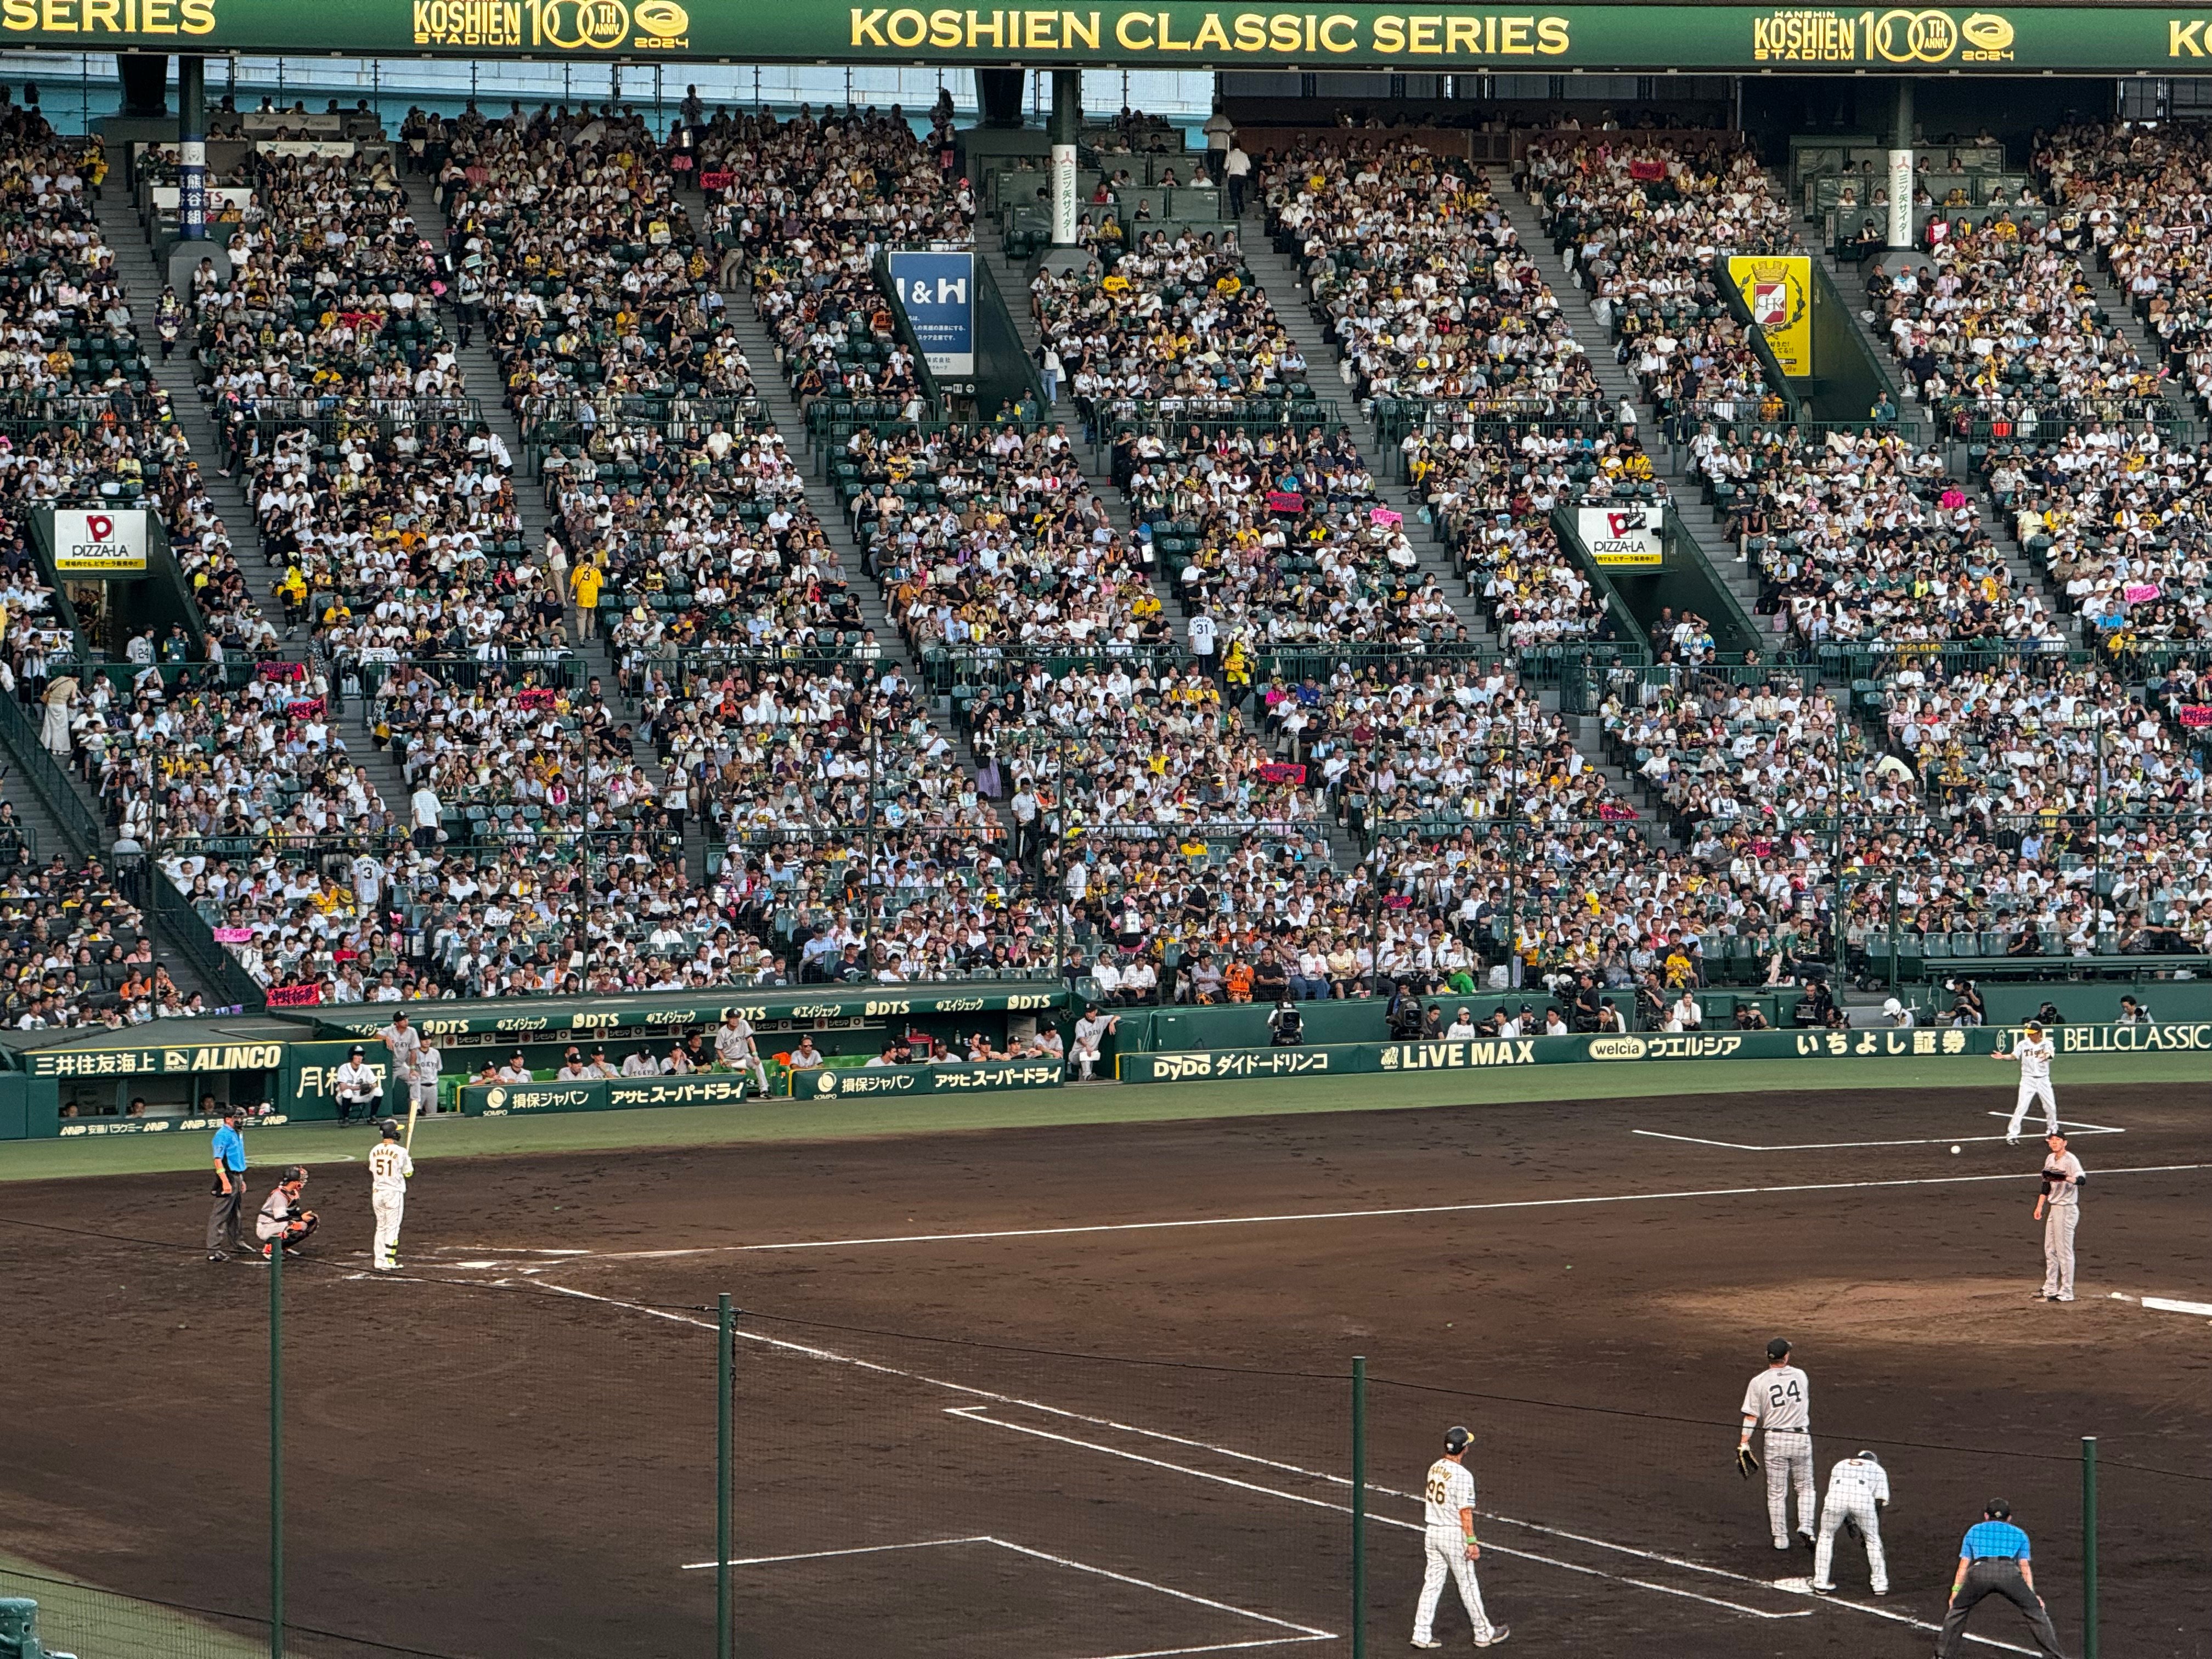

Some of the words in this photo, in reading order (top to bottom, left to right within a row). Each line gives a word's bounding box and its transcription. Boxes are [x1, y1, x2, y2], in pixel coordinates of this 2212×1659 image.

[2, 0, 216, 35] SERIES
[414, 1, 521, 33] KOSHIEN
[598, 5, 616, 23] TH
[850, 8, 1101, 49] KOSHIEN
[1116, 12, 1358, 53] CLASSIC
[1372, 15, 1570, 55] SERIES
[1754, 19, 1855, 49] KOSHIEN
[1859, 10, 1957, 63] 100
[1928, 20, 1944, 37] TH
[414, 33, 520, 46] STADIUM
[634, 37, 689, 48] 2024
[1754, 49, 1854, 60] STADIUM
[1962, 50, 2014, 61] 2024
[187, 173, 201, 224] 熊谷組
[1062, 169, 1073, 238] 三ツ矢サイダー
[1898, 174, 1909, 241] 三ツ矢サイダー
[912, 280, 932, 304] &
[938, 278, 966, 304] H
[72, 544, 129, 557] PIZZA-LA
[1594, 541, 1646, 552] PIZZA-LA
[583, 571, 591, 581] 3
[1196, 624, 1209, 635] 31
[363, 867, 373, 879] 3
[800, 1004, 841, 1018] エイジェック
[878, 1001, 910, 1015] DTS
[944, 997, 984, 1011] エイジェック
[1018, 995, 1051, 1009] DTS
[504, 1017, 548, 1031] エイジェック
[585, 1013, 619, 1028] DTS
[653, 1009, 696, 1024] エイジェック
[436, 1020, 469, 1034] DTS
[1647, 1036, 1741, 1057] ウエルシア
[1797, 1031, 1966, 1055] いちよし証券
[2063, 1025, 2212, 1052] BELLCLASSIC
[1403, 1043, 1464, 1069] LiVE
[1472, 1040, 1534, 1066] MAX
[1595, 1042, 1640, 1055] welcia
[35, 1052, 155, 1075] 三井住友海上
[191, 1046, 281, 1071] ALINCO
[1216, 1053, 1328, 1076] ダイドードリンコ
[935, 1066, 1062, 1087] アサヒスーパードライ
[1154, 1060, 1211, 1080] DyDo
[611, 1082, 744, 1104] アサヒスーパードライ
[842, 1075, 915, 1093] 損保ジャパン
[512, 1090, 589, 1109] 損保ジャパン
[376, 1159, 392, 1177] 51
[1769, 1380, 1802, 1408] 24
